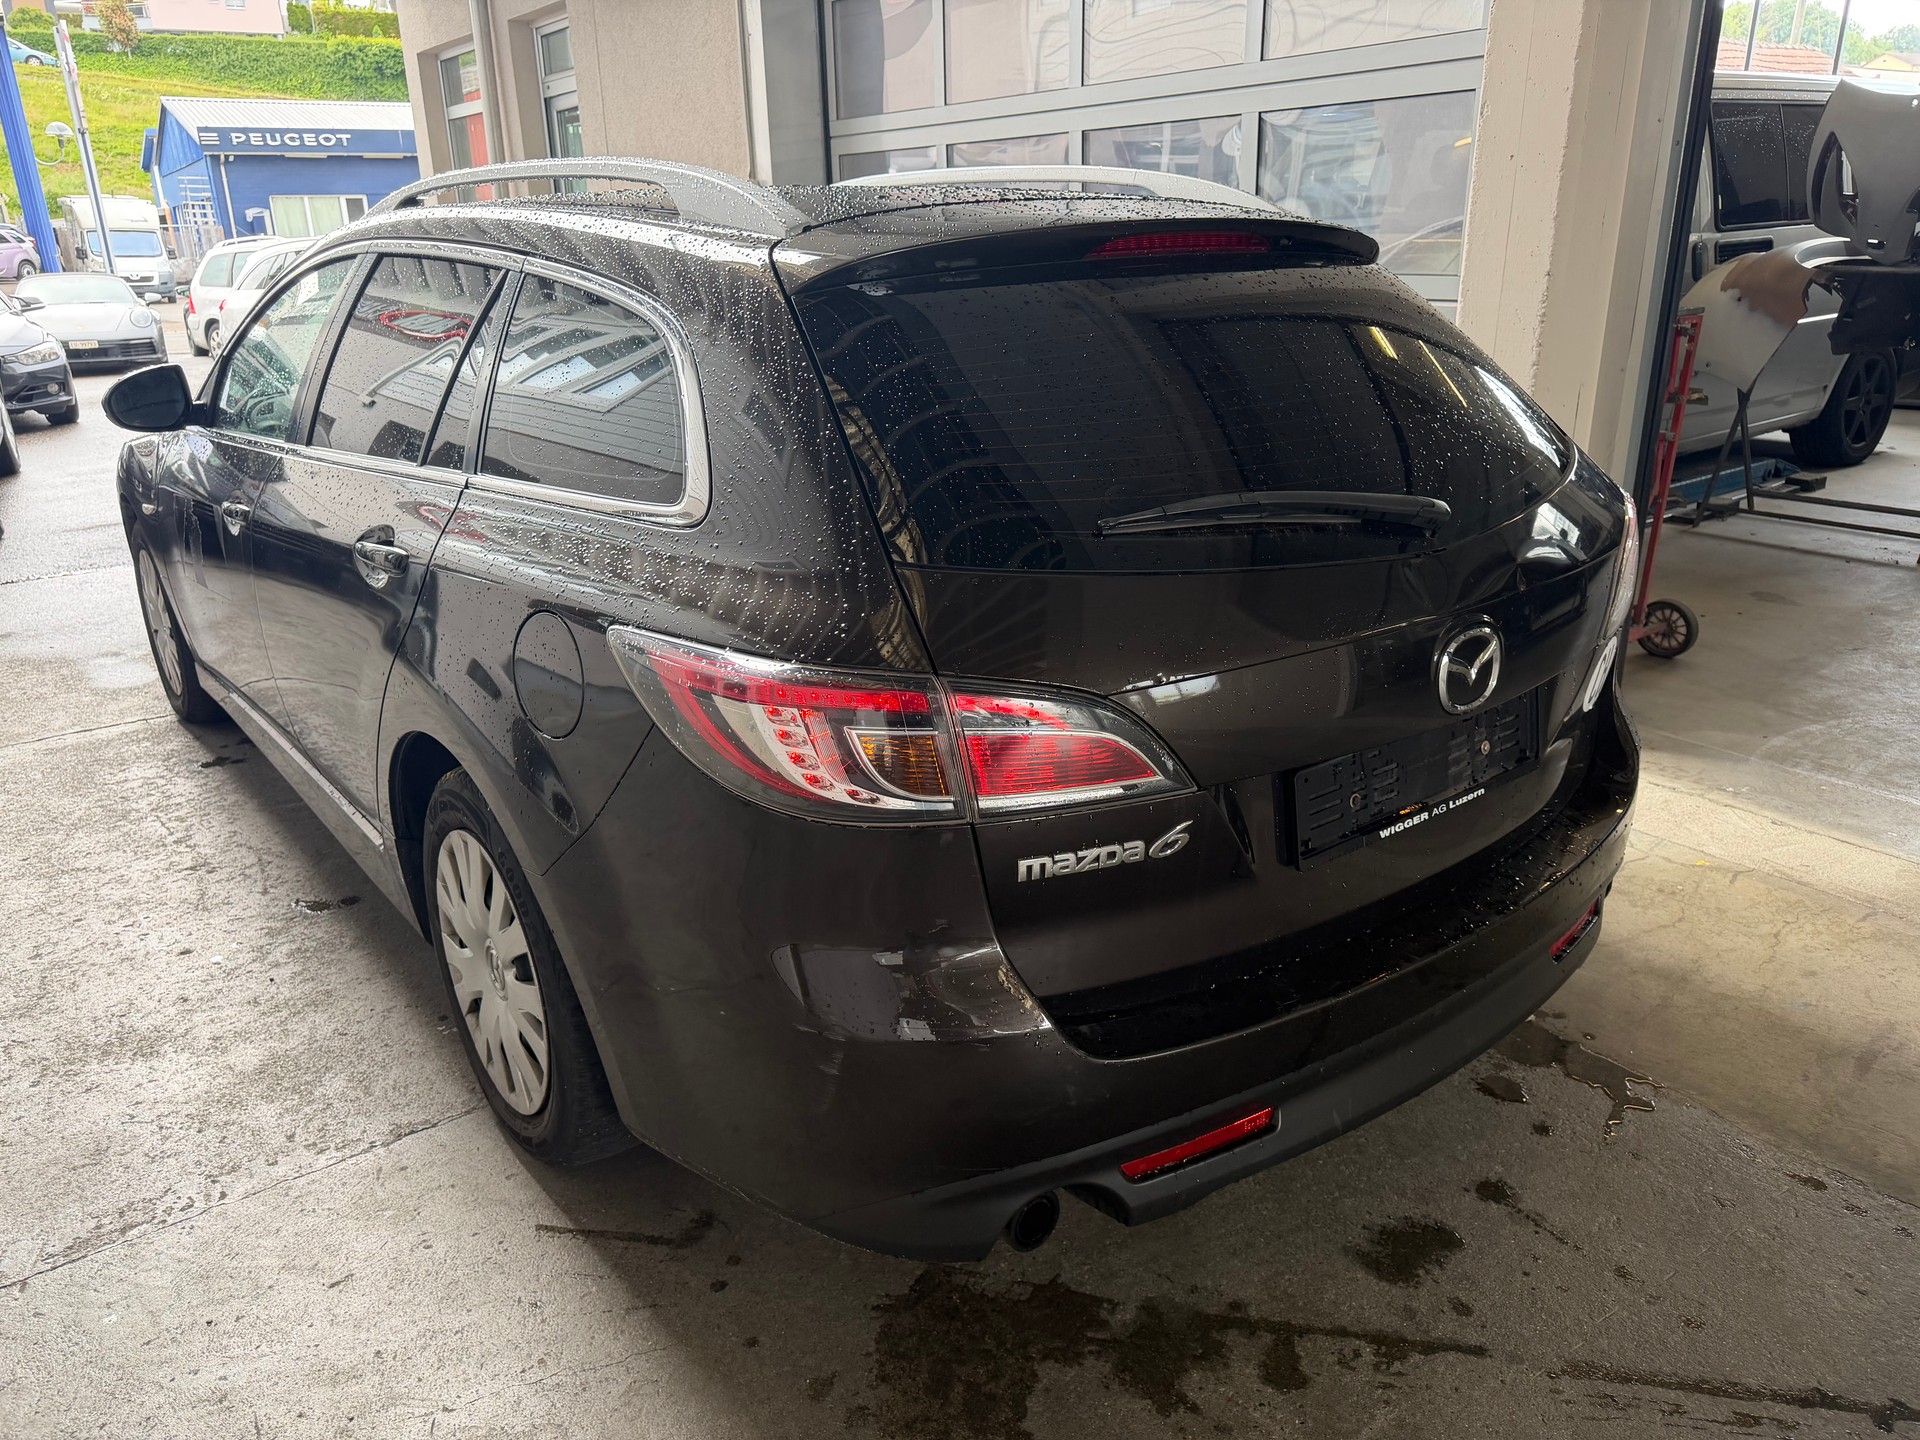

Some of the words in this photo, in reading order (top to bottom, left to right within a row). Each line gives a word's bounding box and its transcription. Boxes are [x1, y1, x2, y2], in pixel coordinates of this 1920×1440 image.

[230, 132, 352, 147] PEUGEOT
[1379, 811, 1429, 839] WIGGER
[1431, 804, 1447, 817] AG
[1448, 787, 1485, 809] Luzern
